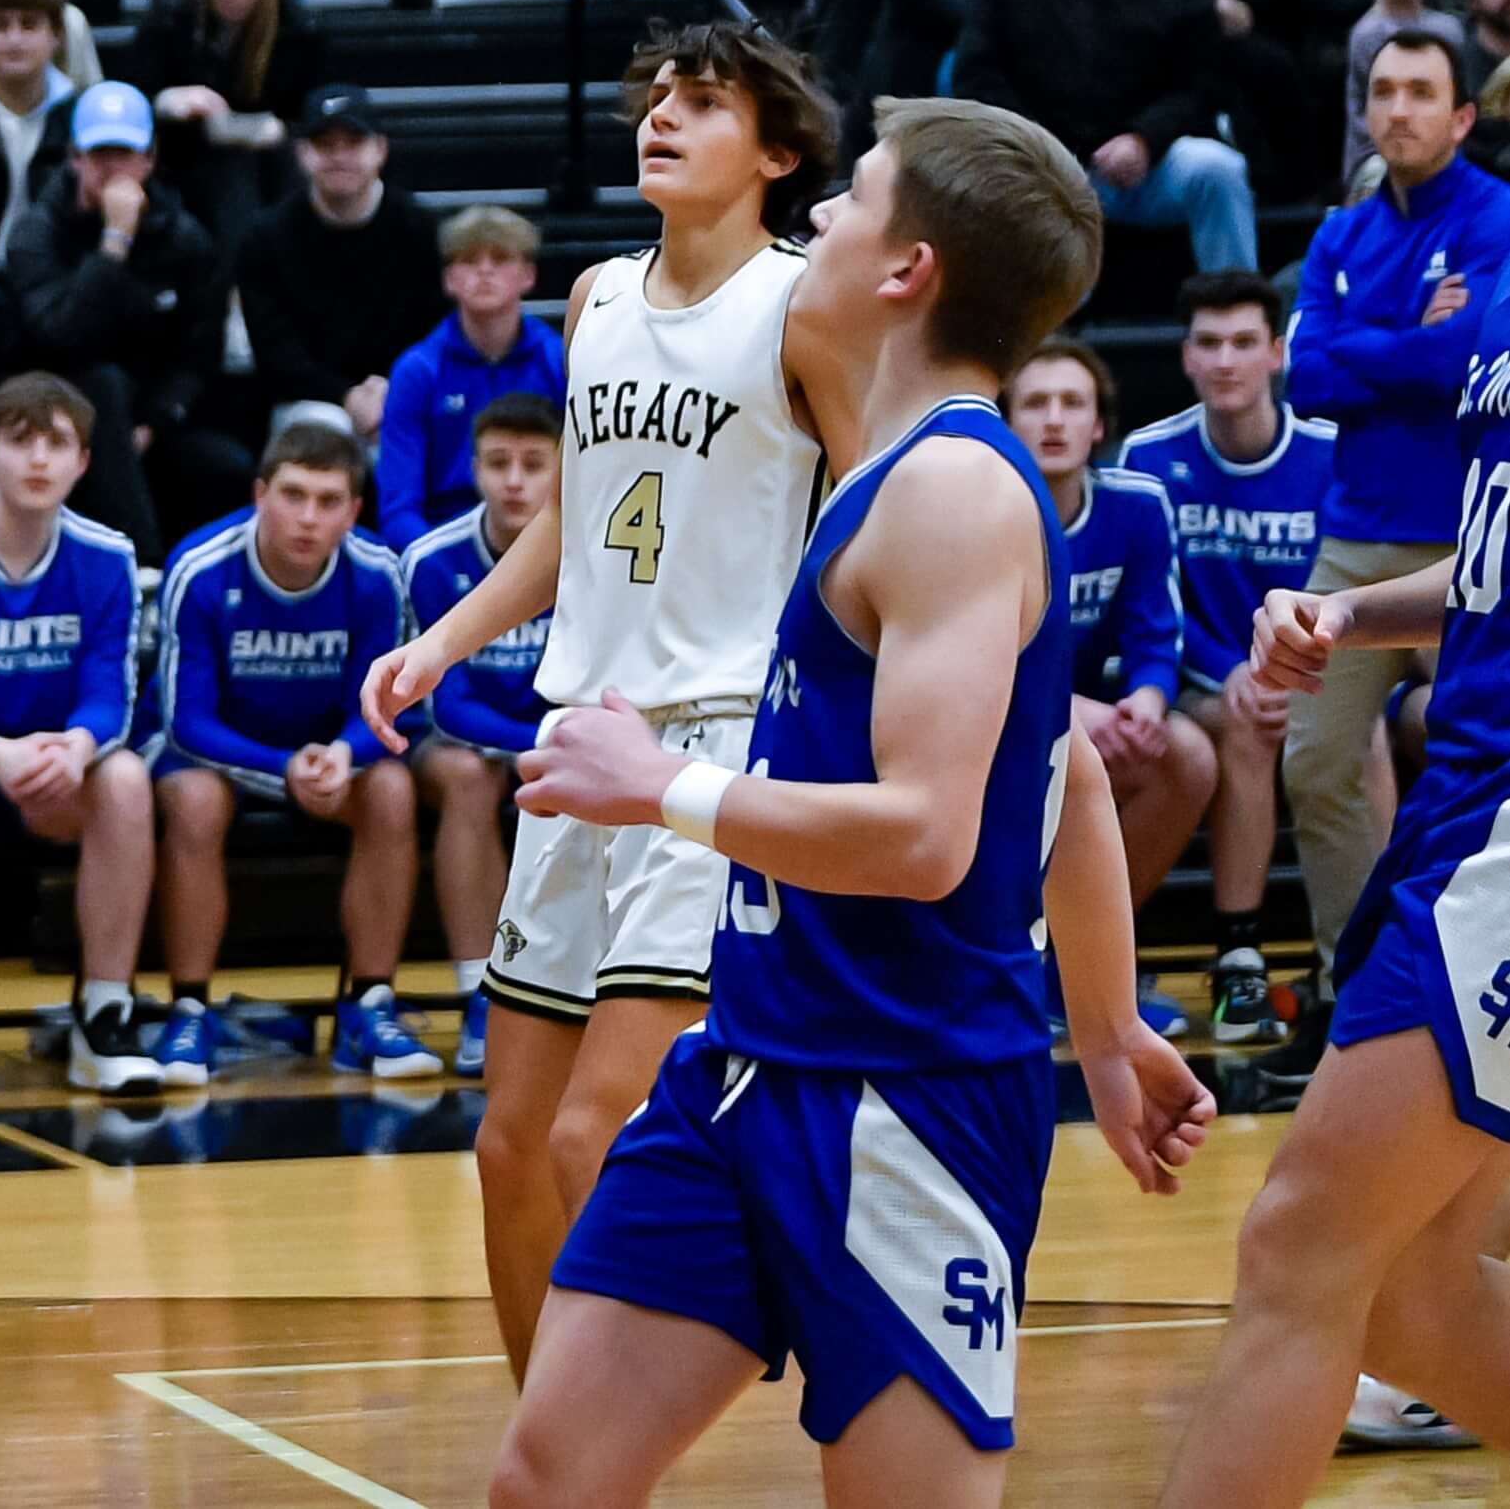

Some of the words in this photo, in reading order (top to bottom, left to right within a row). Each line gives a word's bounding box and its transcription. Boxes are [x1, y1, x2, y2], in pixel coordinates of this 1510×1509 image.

[569, 380, 740, 459] LEGACY
[604, 471, 665, 584] 4
[1178, 504, 1317, 542] SAINTS
[942, 1256, 1006, 1352] SM
